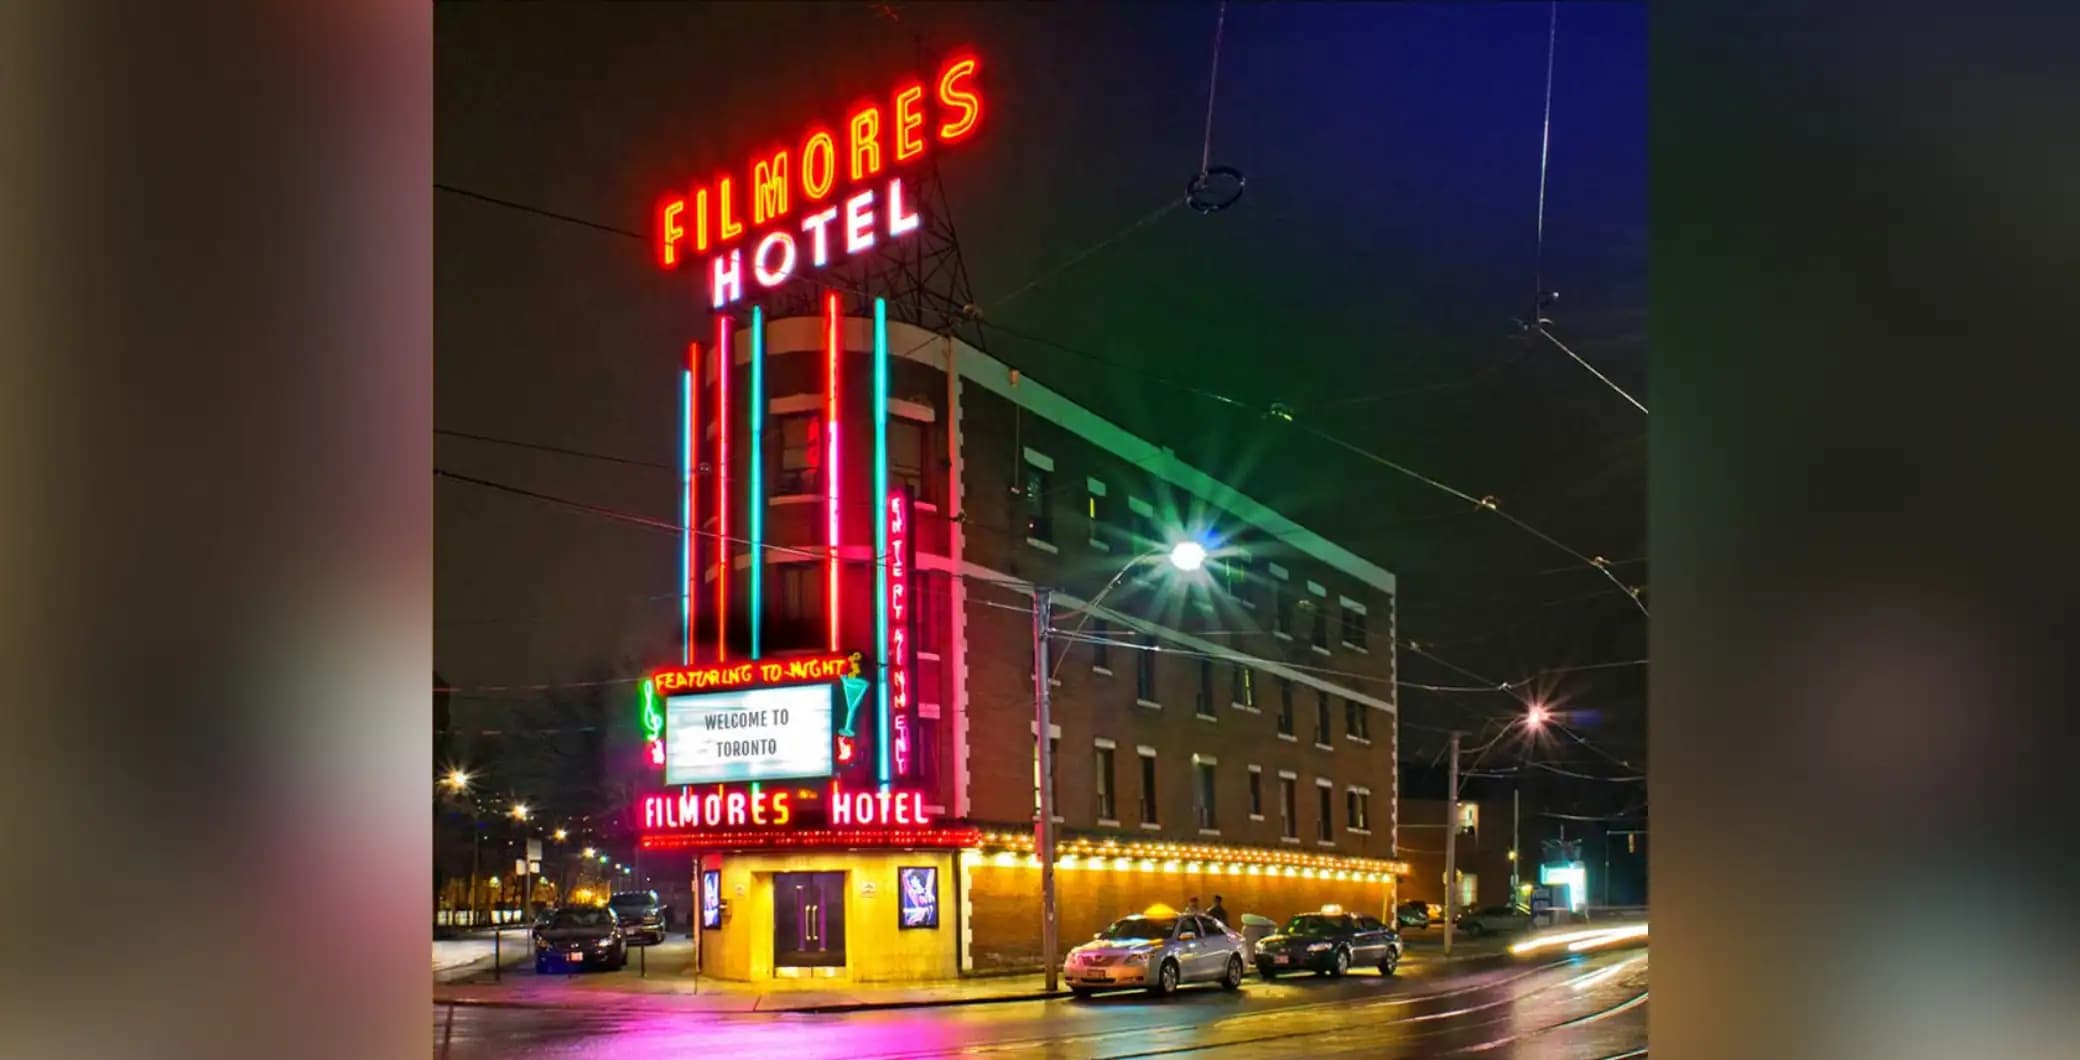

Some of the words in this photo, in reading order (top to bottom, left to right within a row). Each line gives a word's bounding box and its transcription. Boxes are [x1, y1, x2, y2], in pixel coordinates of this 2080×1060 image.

[663, 59, 979, 265] FILMORES
[713, 177, 920, 309] HOTEL
[891, 497, 907, 774] ENTERTAINMENT
[655, 664, 752, 690] FEATURING
[704, 711, 767, 731] WELCOME
[774, 709, 789, 726] TO
[716, 739, 777, 757] TORONTO
[645, 792, 789, 828] FILMORES
[832, 791, 929, 824] HOTEL
